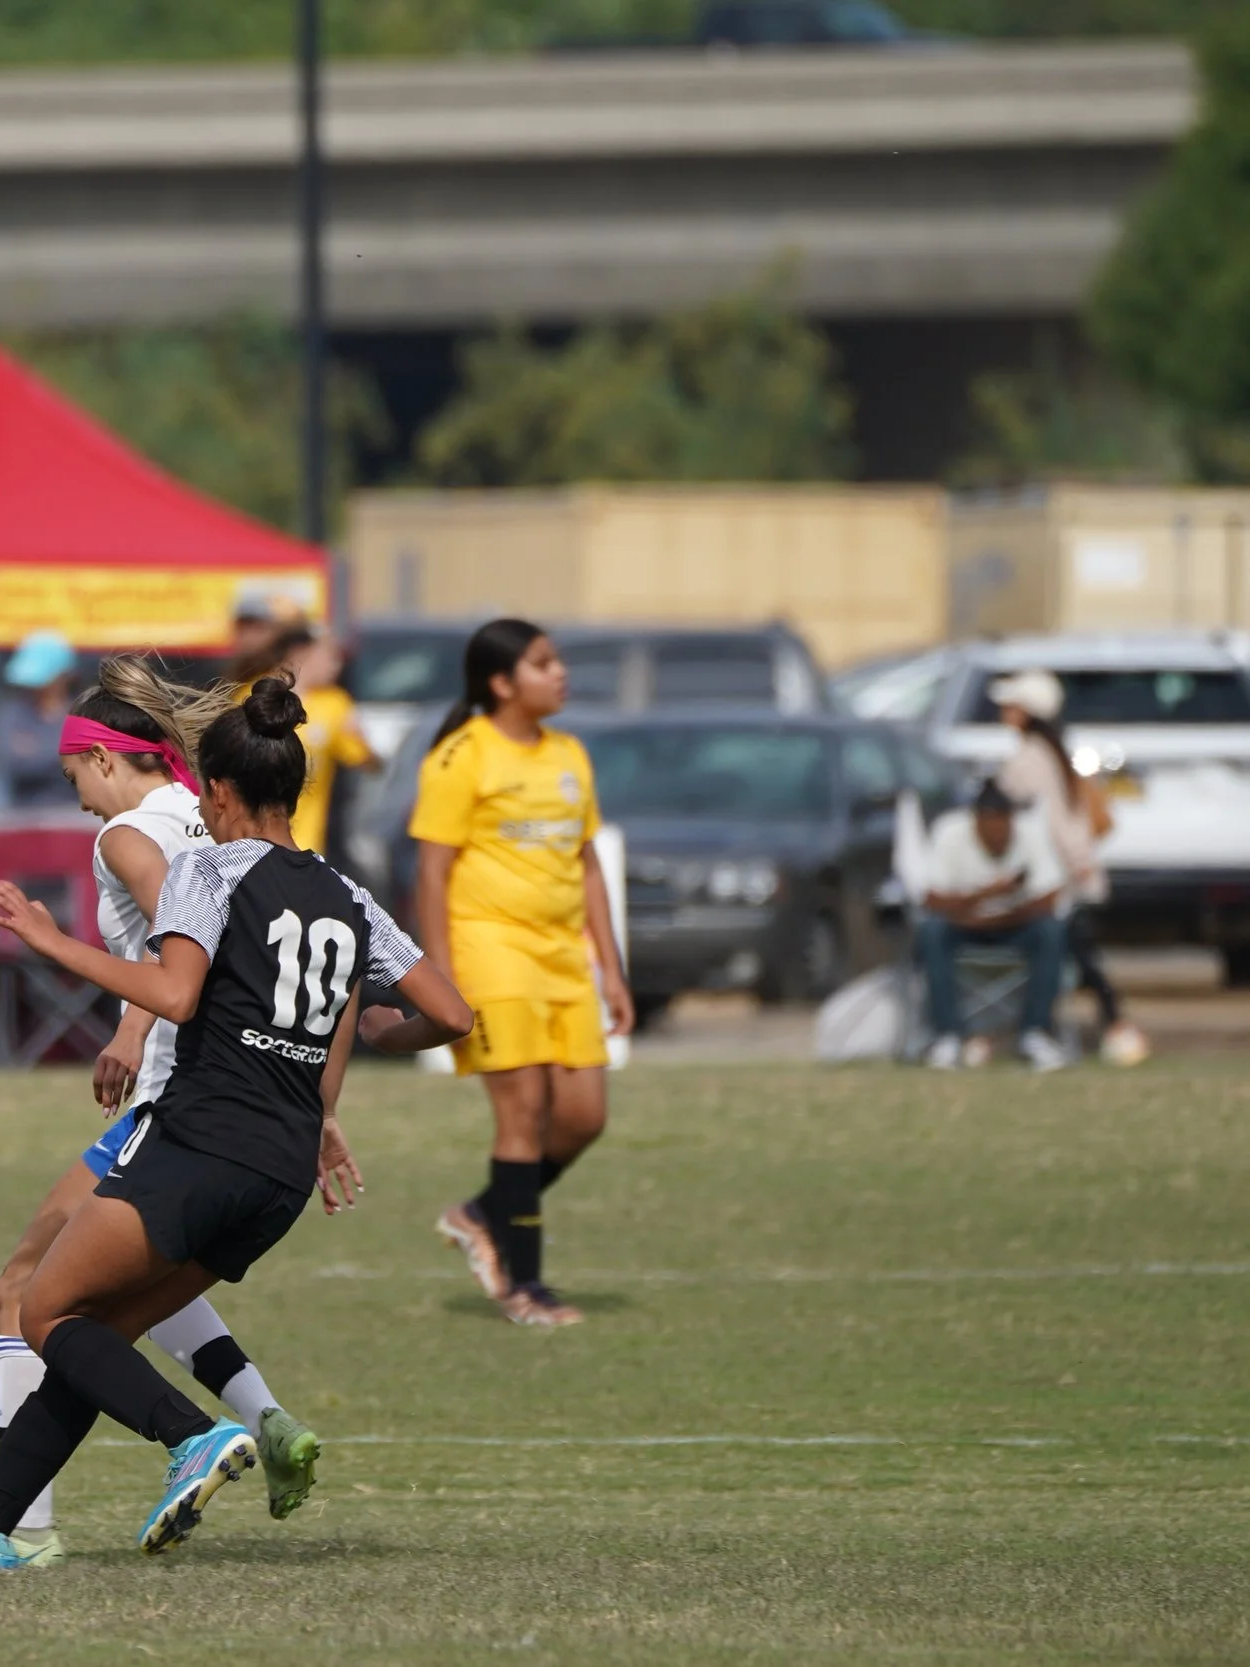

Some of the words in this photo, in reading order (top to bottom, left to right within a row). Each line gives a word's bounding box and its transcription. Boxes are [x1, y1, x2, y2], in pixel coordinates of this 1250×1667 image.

[185, 823, 210, 838] LO
[267, 908, 356, 1036] 10
[240, 1028, 328, 1064] SOCCER.CO
